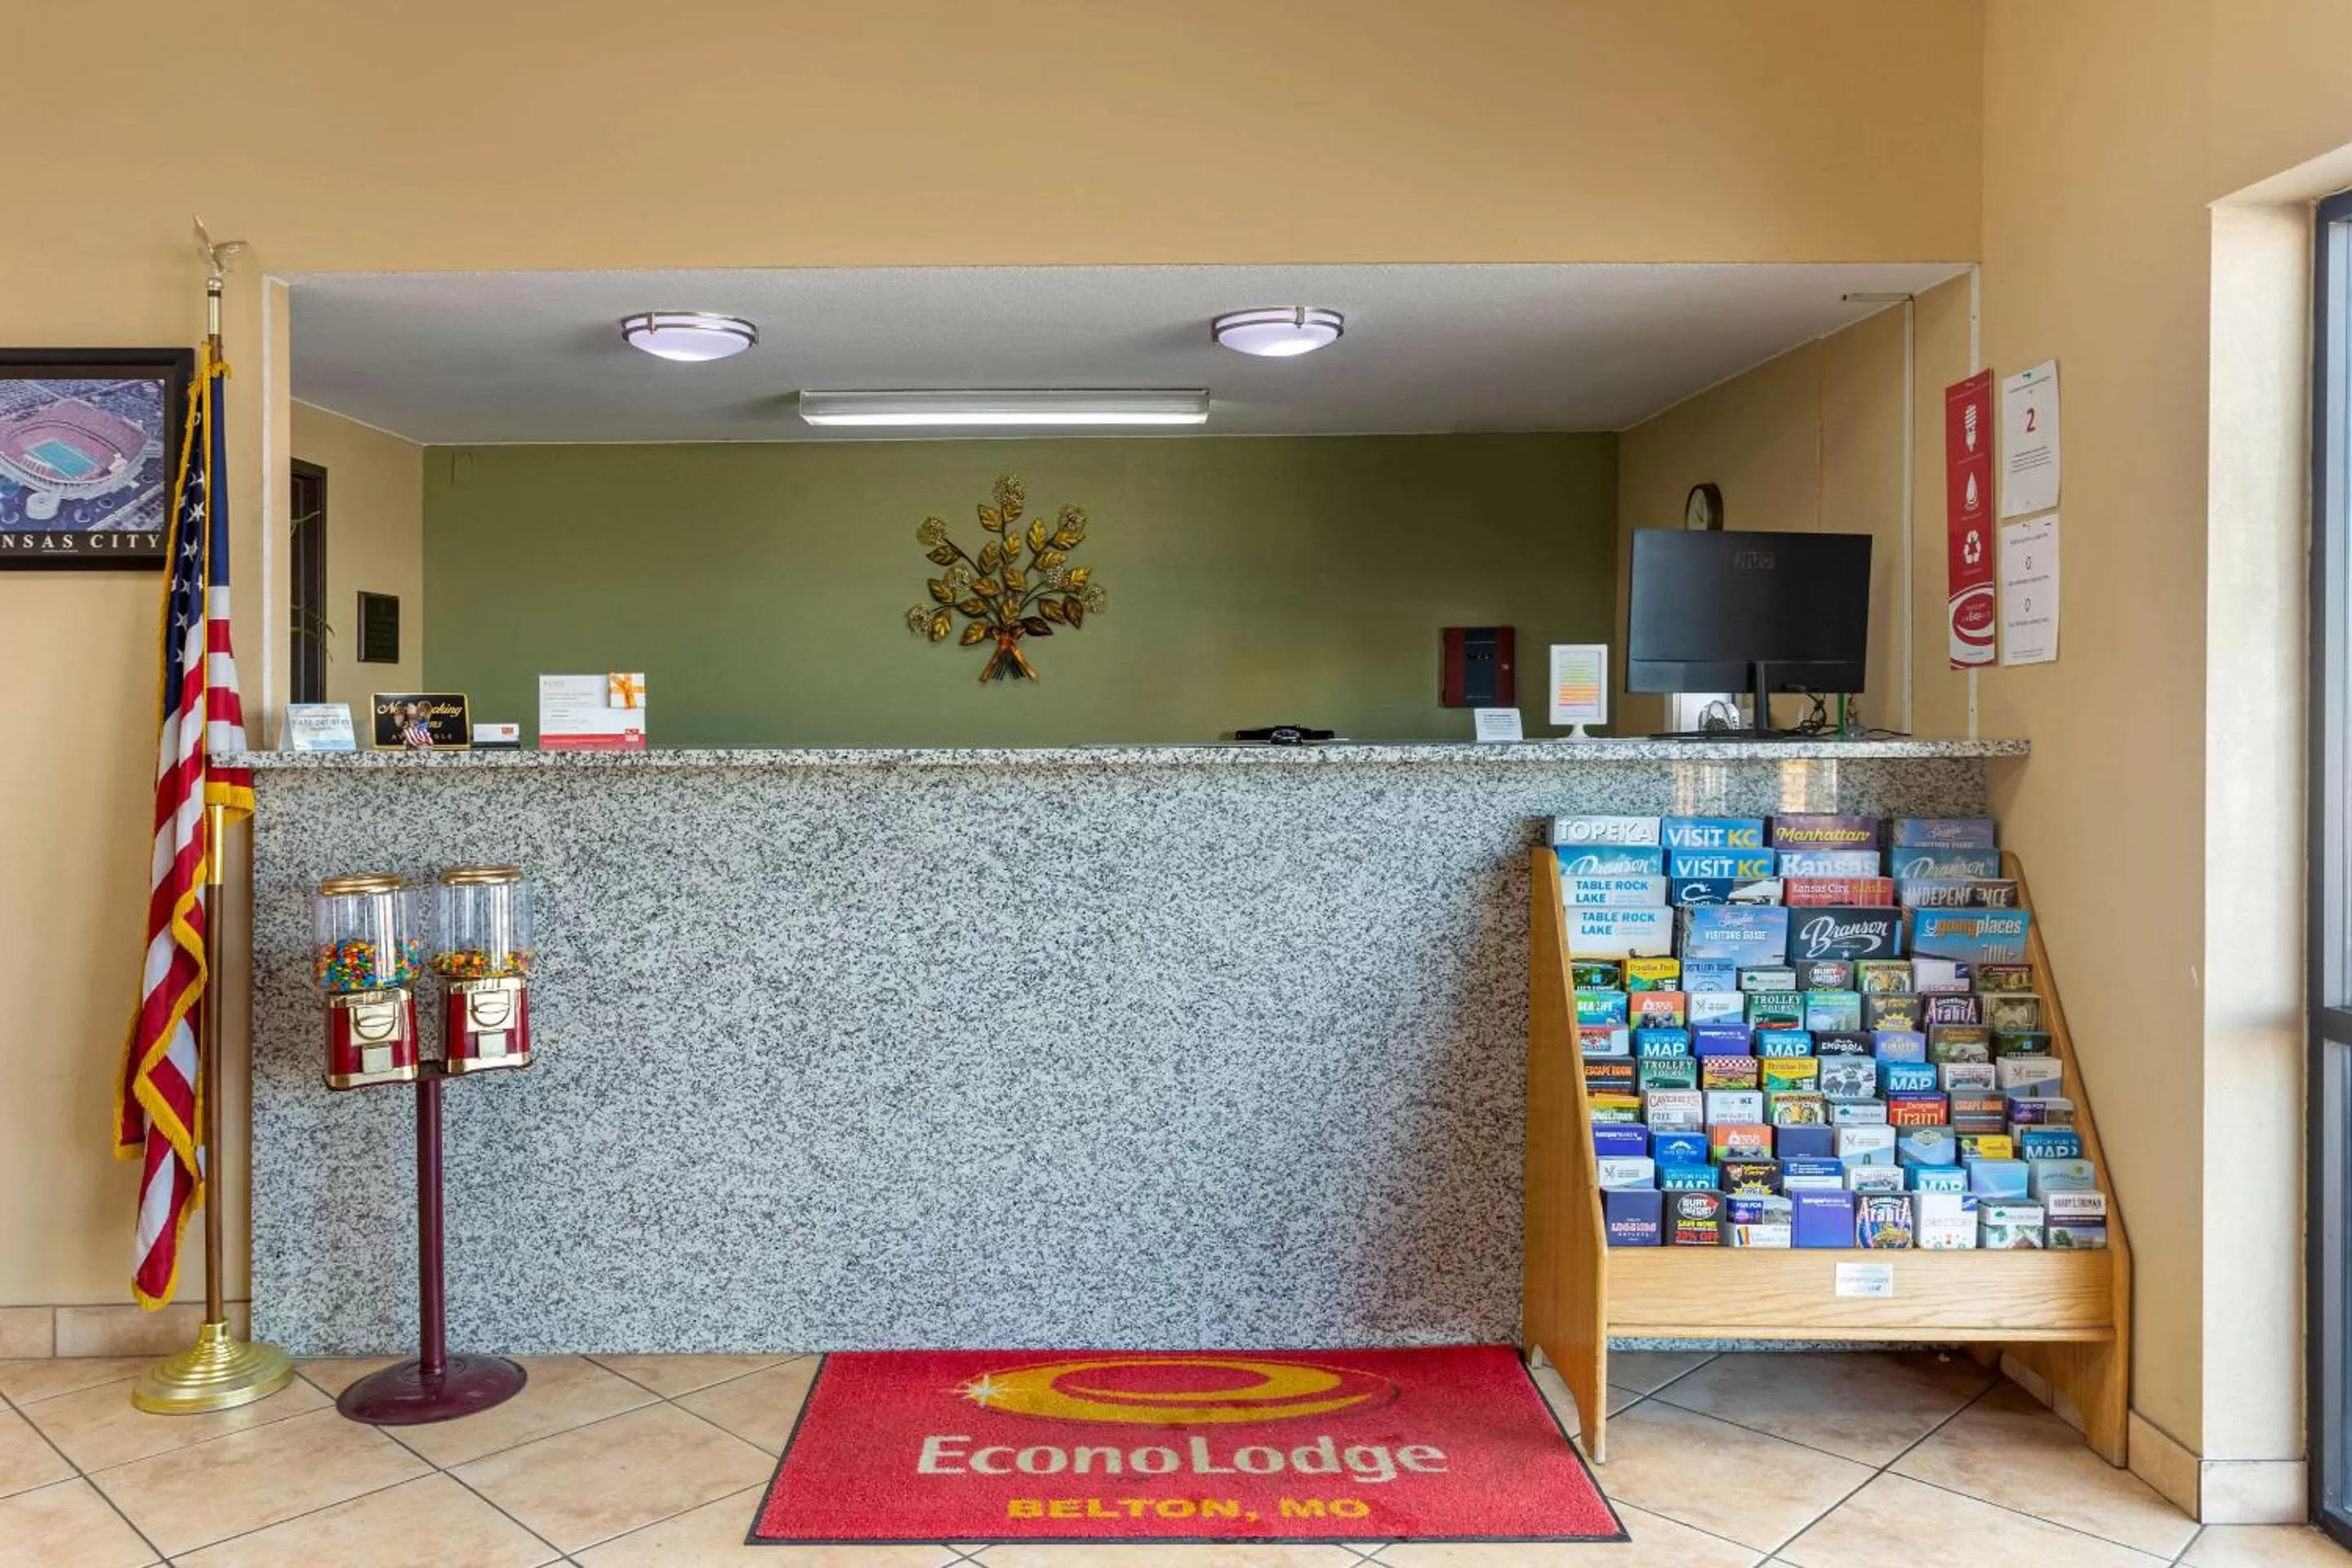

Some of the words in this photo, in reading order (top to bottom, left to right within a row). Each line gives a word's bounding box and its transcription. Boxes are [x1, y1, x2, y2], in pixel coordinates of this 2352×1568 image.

[2026, 408, 2036, 433] 2
[90, 534, 162, 549] CITY
[1558, 819, 1655, 843] TOPEKA
[1775, 826, 1871, 843] Manhattan
[1668, 829, 1724, 847] VISIT
[1727, 829, 1758, 848] KC
[1677, 859, 1735, 877] VISIT
[1738, 859, 1768, 877] KC
[1779, 854, 1878, 878] Kansas
[1575, 881, 1613, 890] TABLE
[1615, 881, 1649, 891] ROCK
[1793, 884, 1826, 893] Kansas
[1575, 893, 1606, 903] LAKE
[1581, 912, 1617, 922] TABLE
[1622, 912, 1656, 922] ROCK
[1581, 924, 1613, 935] LAKE
[1799, 915, 1889, 958] Branson
[1754, 996, 1802, 1004] TROLLEY
[1644, 1044, 1685, 1057] MAP
[1766, 1044, 1807, 1057] MAP
[1820, 1042, 1864, 1053] EMPORIA
[1645, 1061, 1693, 1070] TROLLEY
[1890, 1078, 1932, 1091] MAP
[1894, 1108, 1944, 1125] Train!
[2026, 1147, 2069, 1159] MAP
[1919, 1179, 1963, 1192] MAP
[1007, 1498, 1259, 1522] BELTON,
[1279, 1496, 1370, 1519] MO
